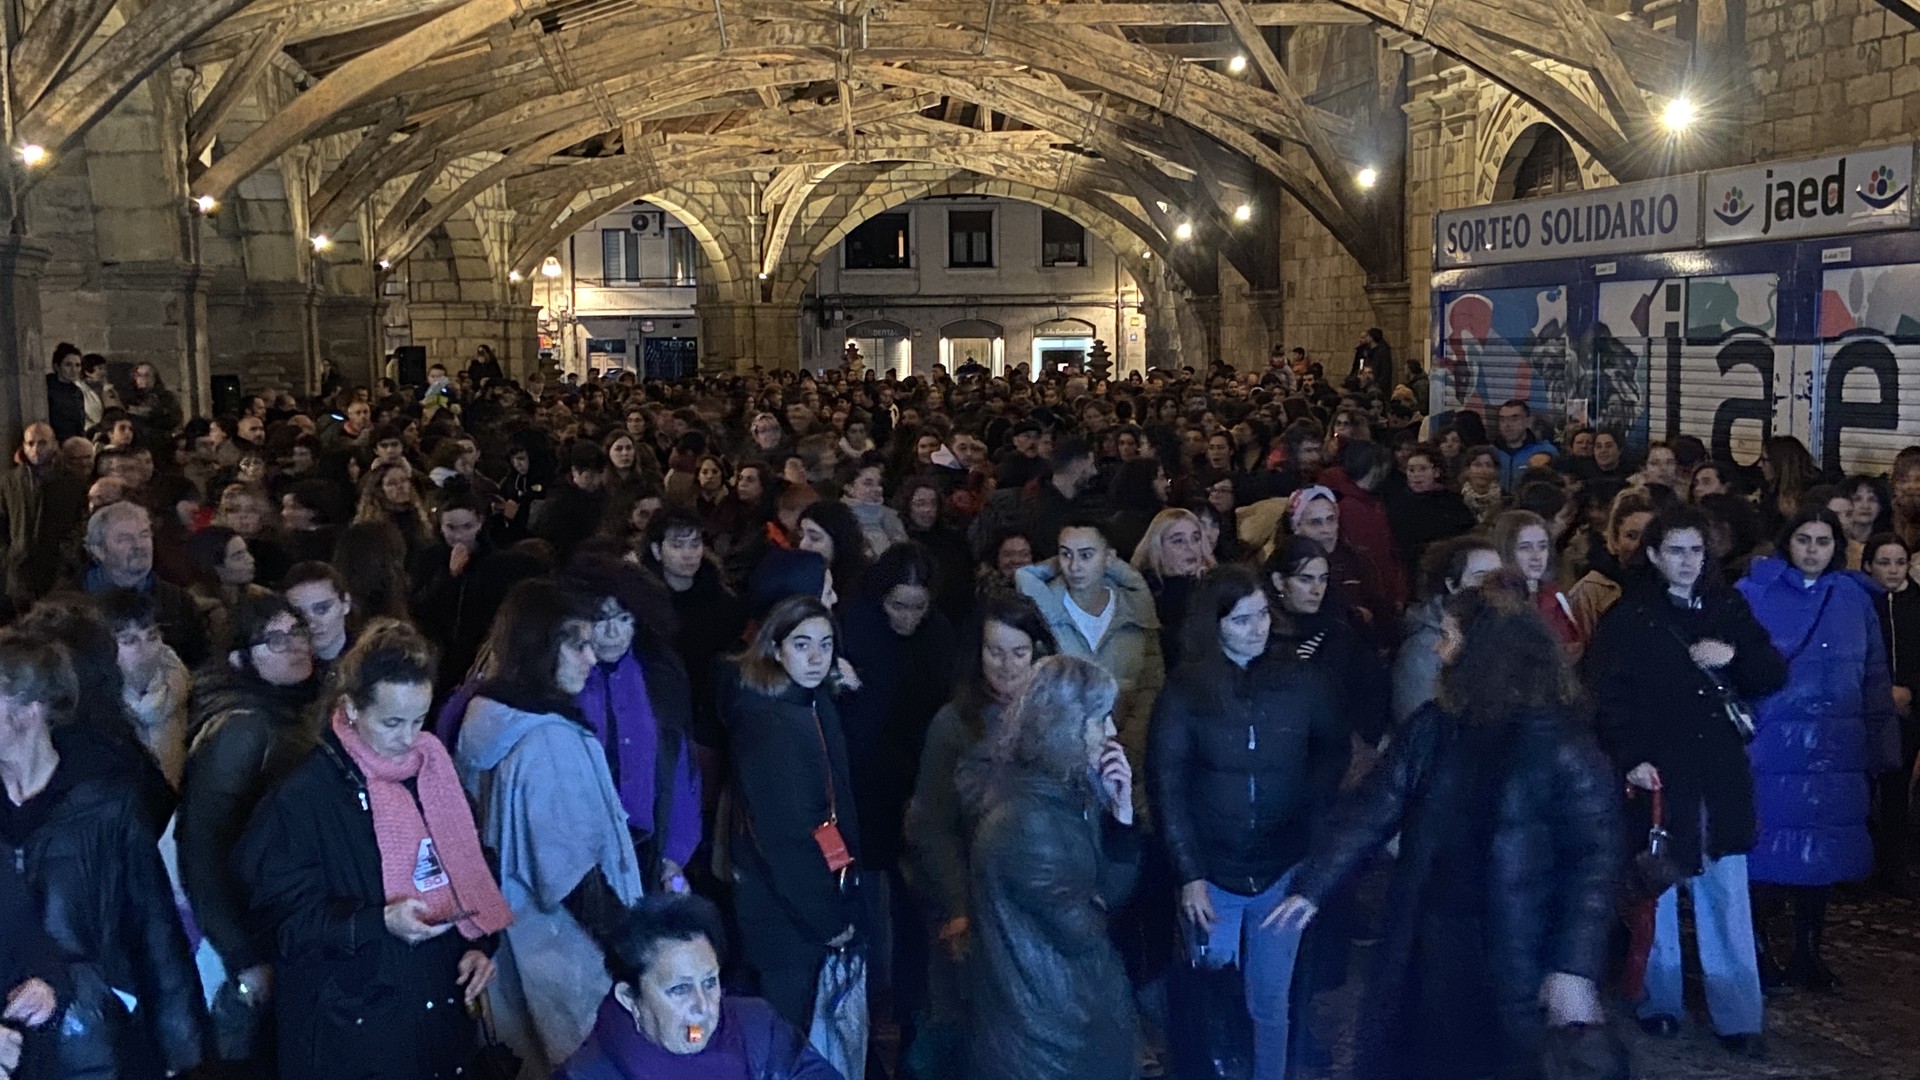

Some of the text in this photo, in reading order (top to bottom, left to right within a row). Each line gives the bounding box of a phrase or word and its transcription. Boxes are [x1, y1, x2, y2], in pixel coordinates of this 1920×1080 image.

[1447, 193, 1679, 254] SORTEO SOLIDARIO
[1761, 157, 1846, 235] jaed
